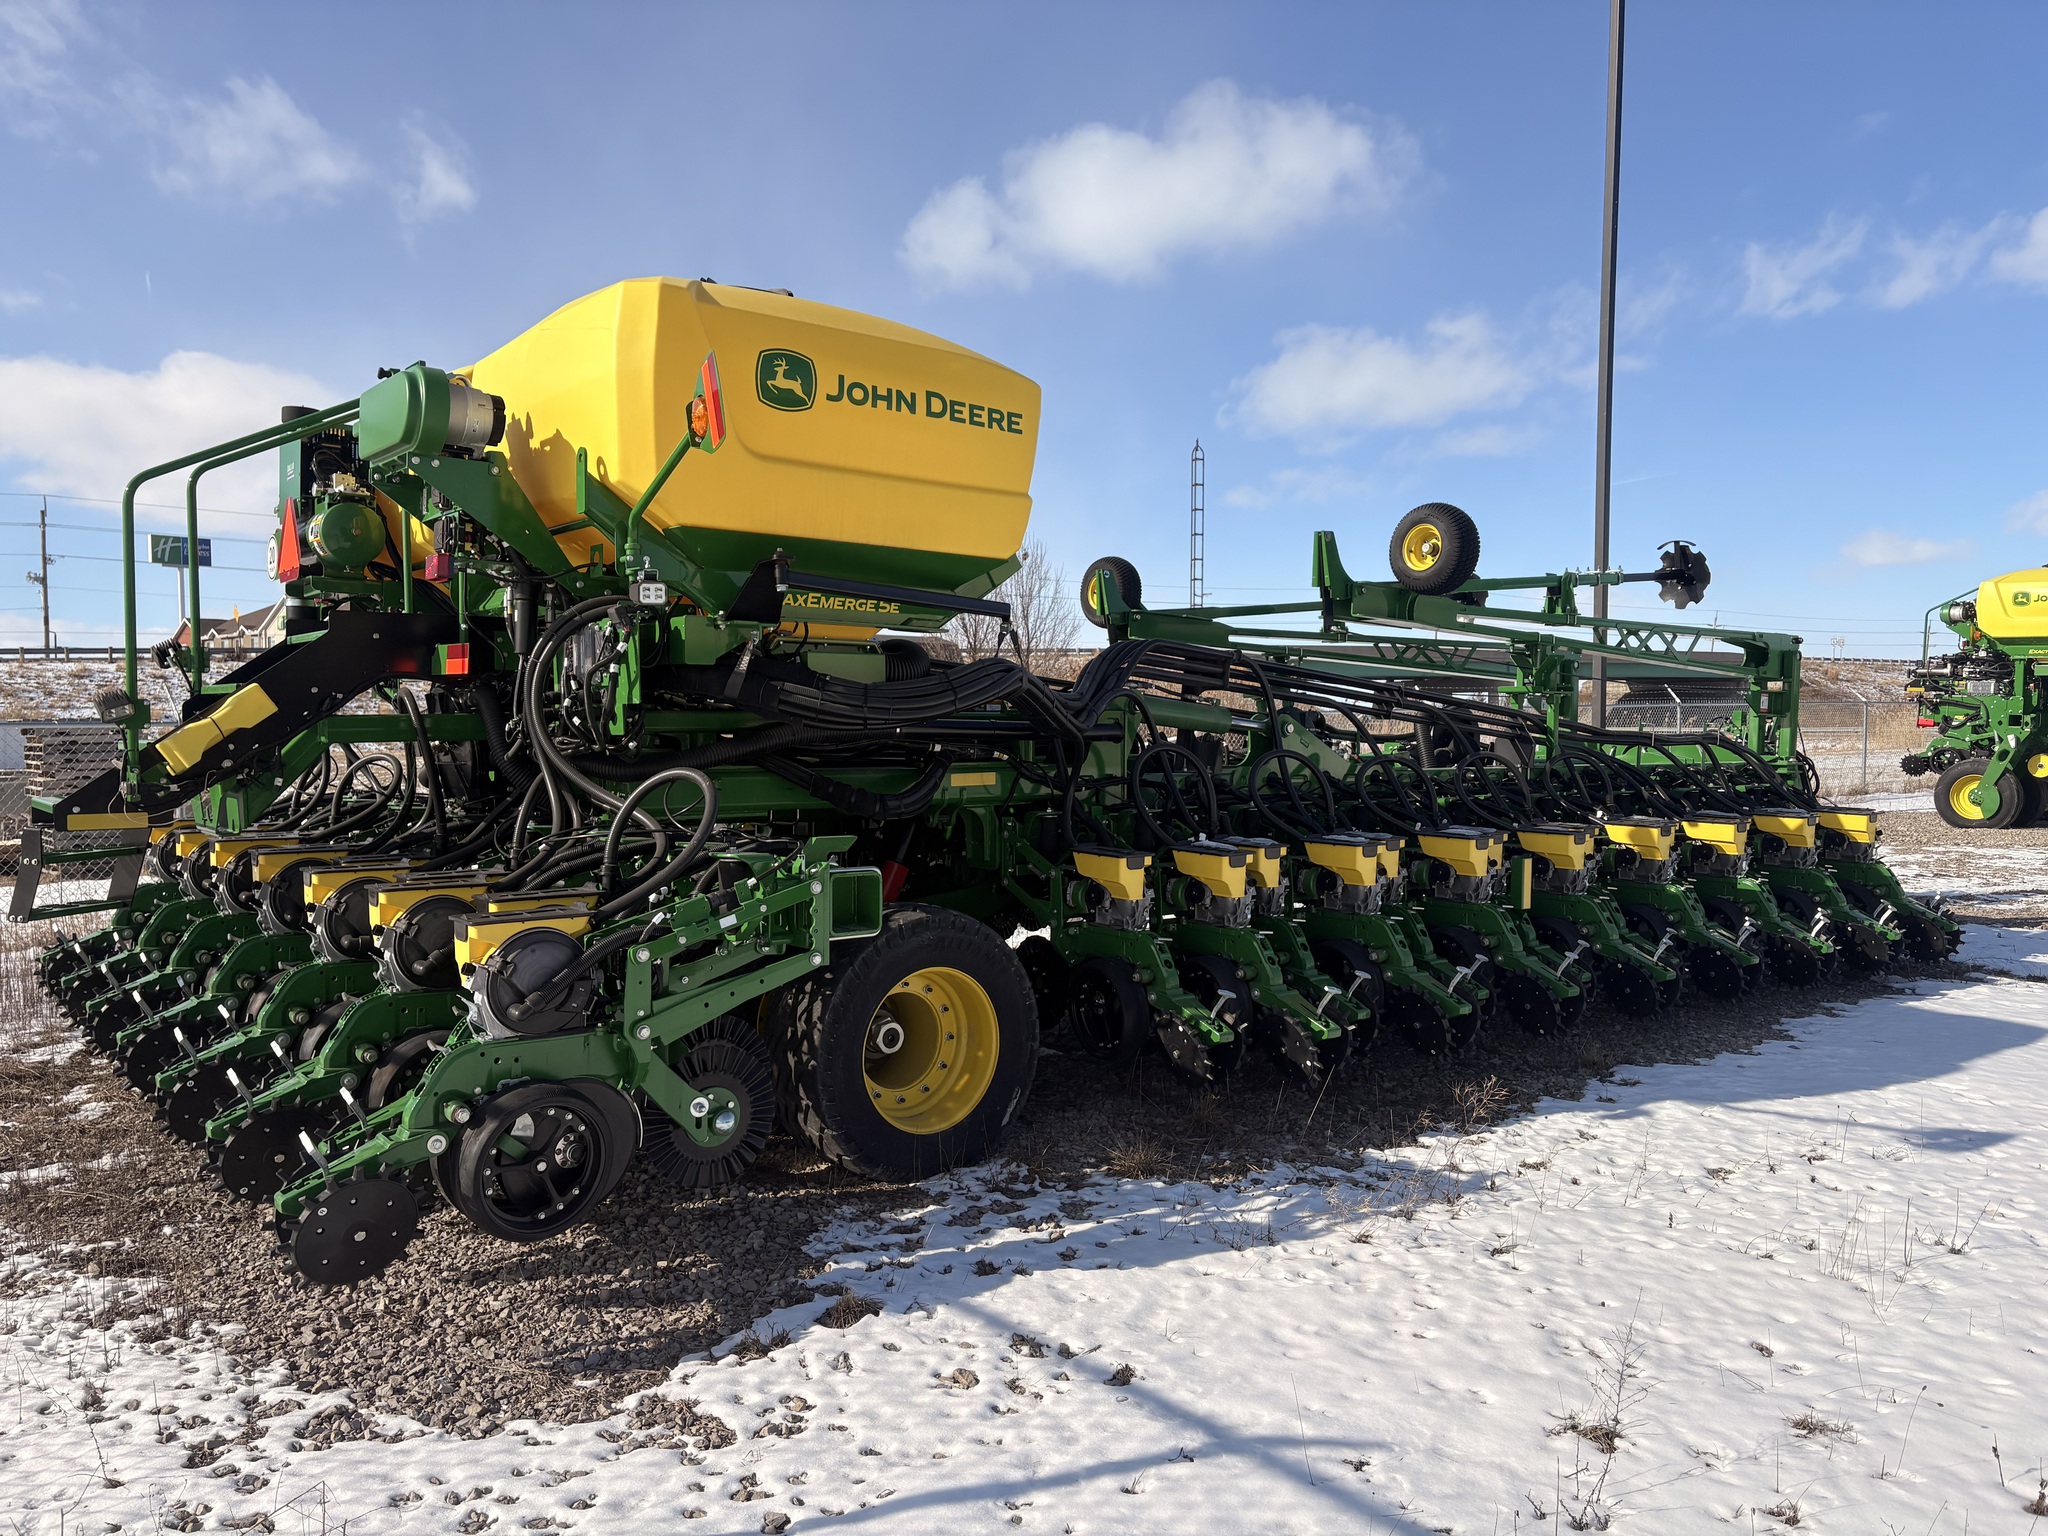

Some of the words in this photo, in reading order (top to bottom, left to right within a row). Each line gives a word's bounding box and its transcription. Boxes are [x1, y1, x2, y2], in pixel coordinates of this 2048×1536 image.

[826, 374, 916, 415] JOHN
[925, 390, 1023, 435] DEERE
[783, 592, 878, 613] AXEMERGE
